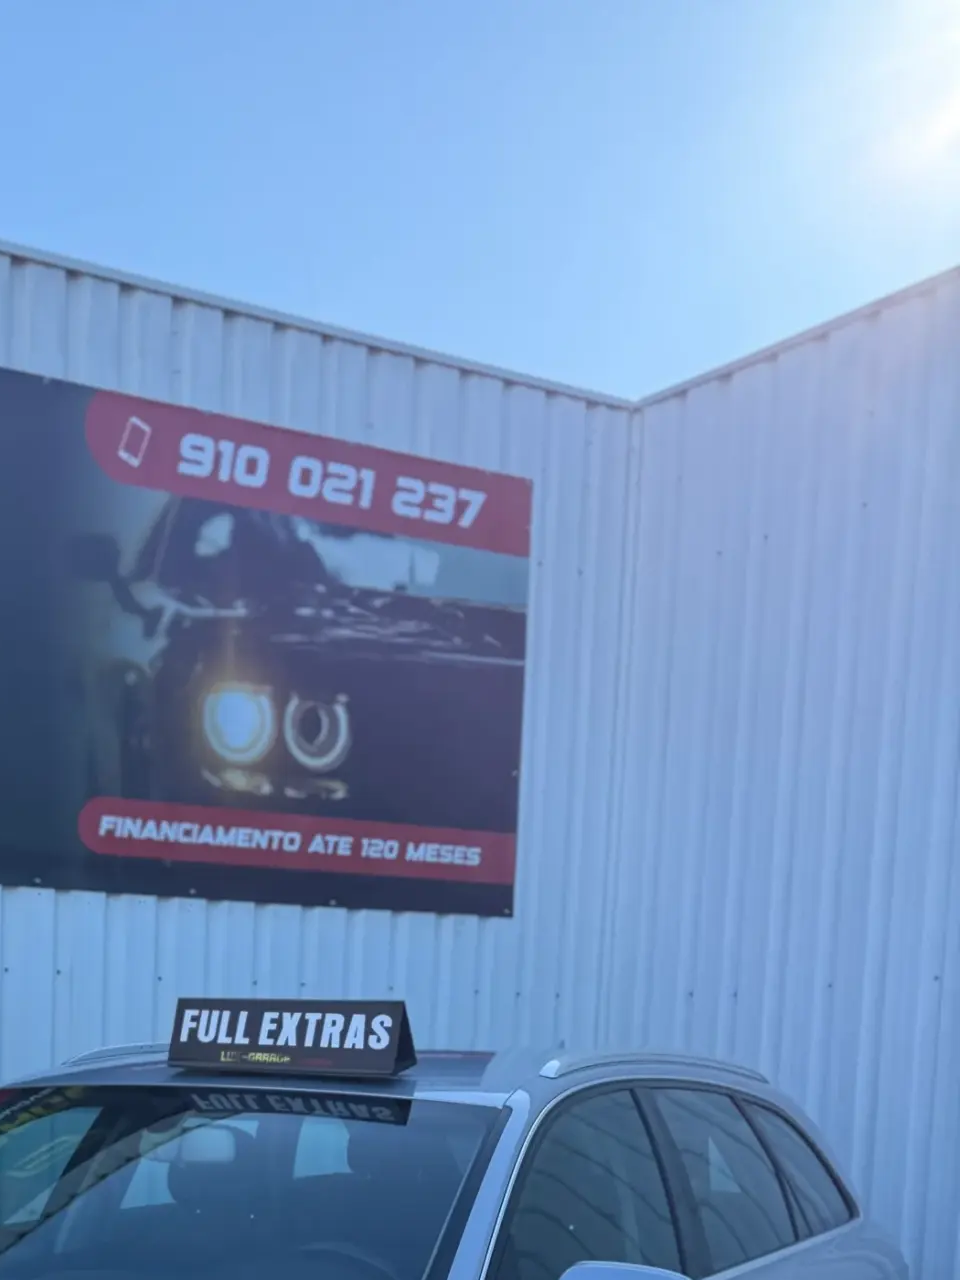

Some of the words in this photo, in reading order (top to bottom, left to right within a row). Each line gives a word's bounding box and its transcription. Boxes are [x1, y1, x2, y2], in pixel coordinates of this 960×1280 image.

[177, 433, 269, 488] 910
[288, 455, 375, 508] 021
[391, 476, 487, 528] 237
[97, 814, 302, 853] FINANCIAMENTO
[307, 834, 354, 857] ATE
[360, 837, 400, 860] 120
[404, 841, 482, 867] MESES
[179, 1008, 249, 1046] FULL
[257, 1011, 393, 1050] EXTRAS
